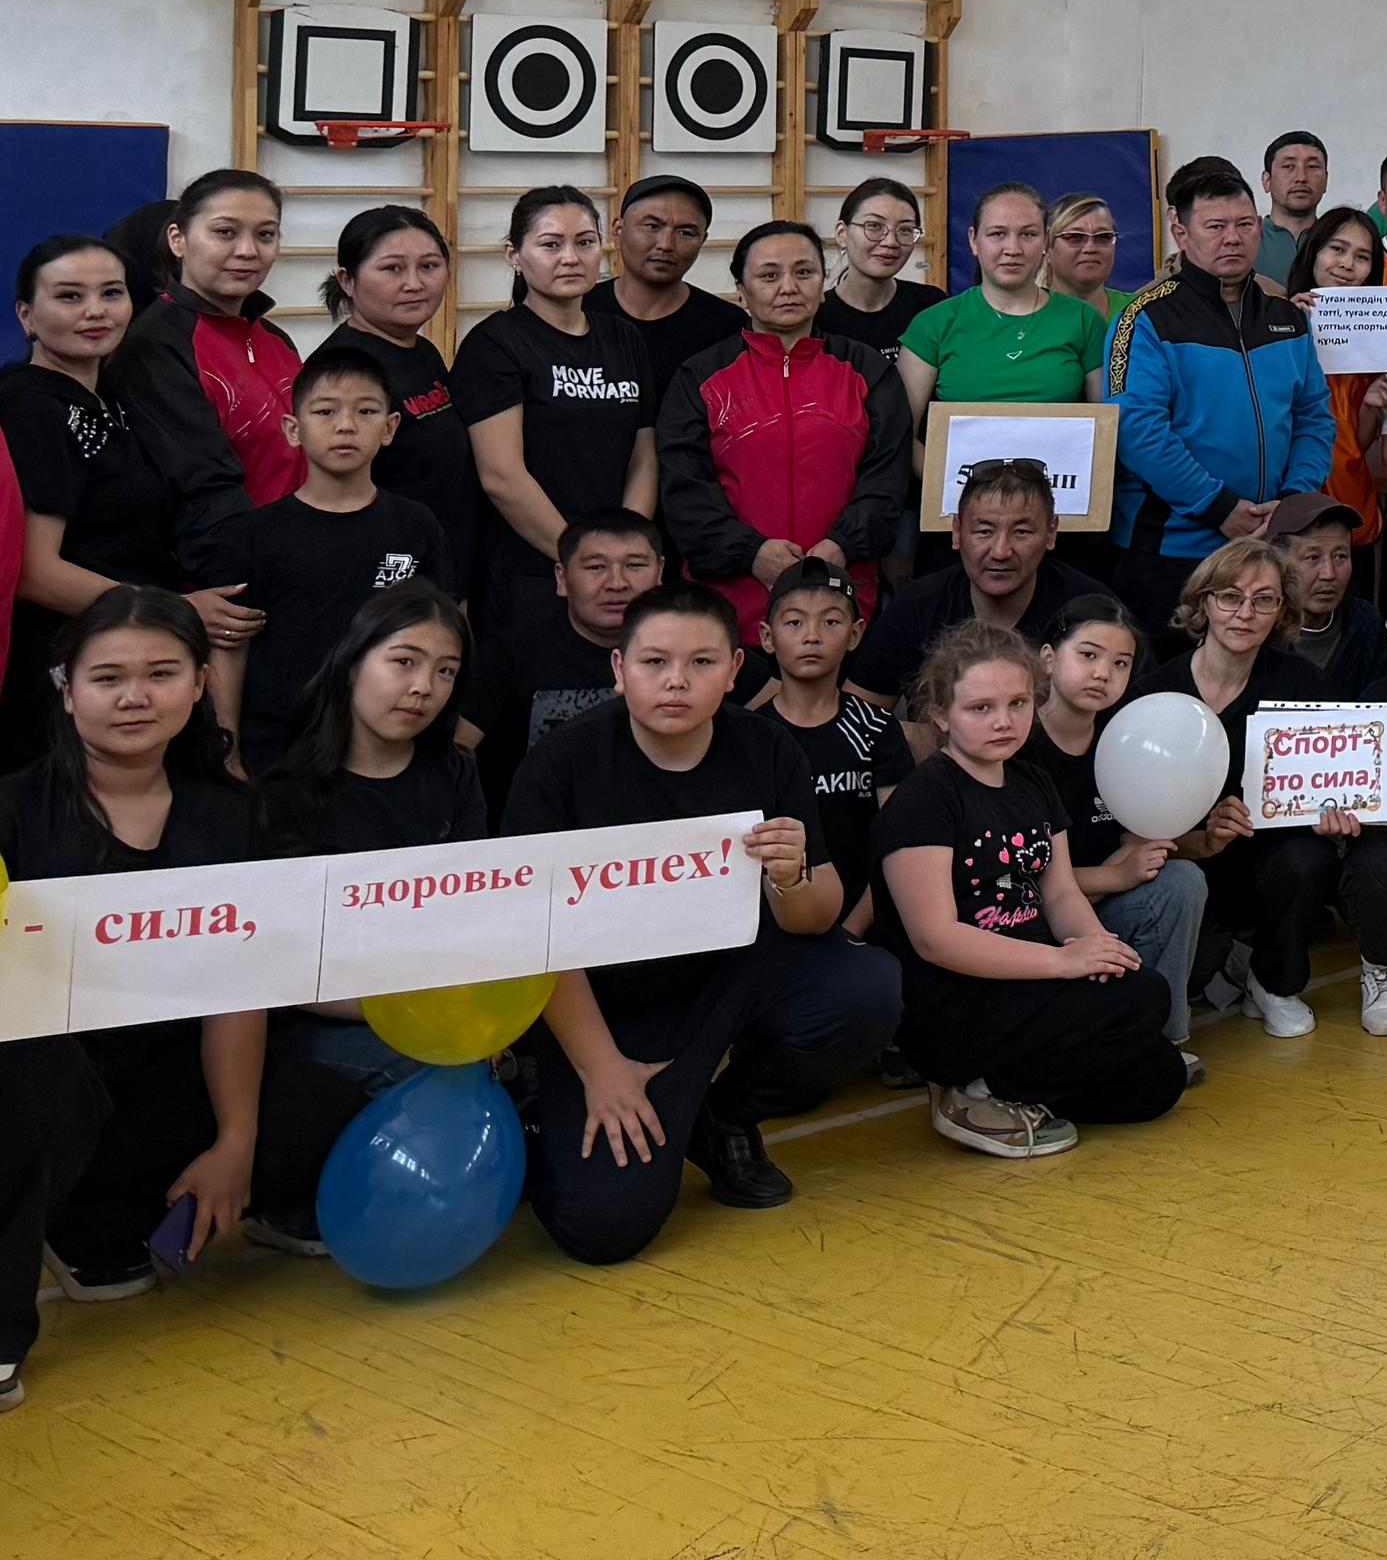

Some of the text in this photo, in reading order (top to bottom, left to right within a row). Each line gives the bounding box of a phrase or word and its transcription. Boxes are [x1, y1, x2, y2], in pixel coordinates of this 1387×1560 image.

[552, 365, 605, 385] MOVE
[553, 380, 639, 399] FORWARD
[1273, 732, 1376, 758] Спорт-
[1264, 767, 1377, 791] это сила,
[95, 903, 256, 945] сила,
[343, 865, 535, 909] здоровье
[567, 838, 732, 905] успех!
